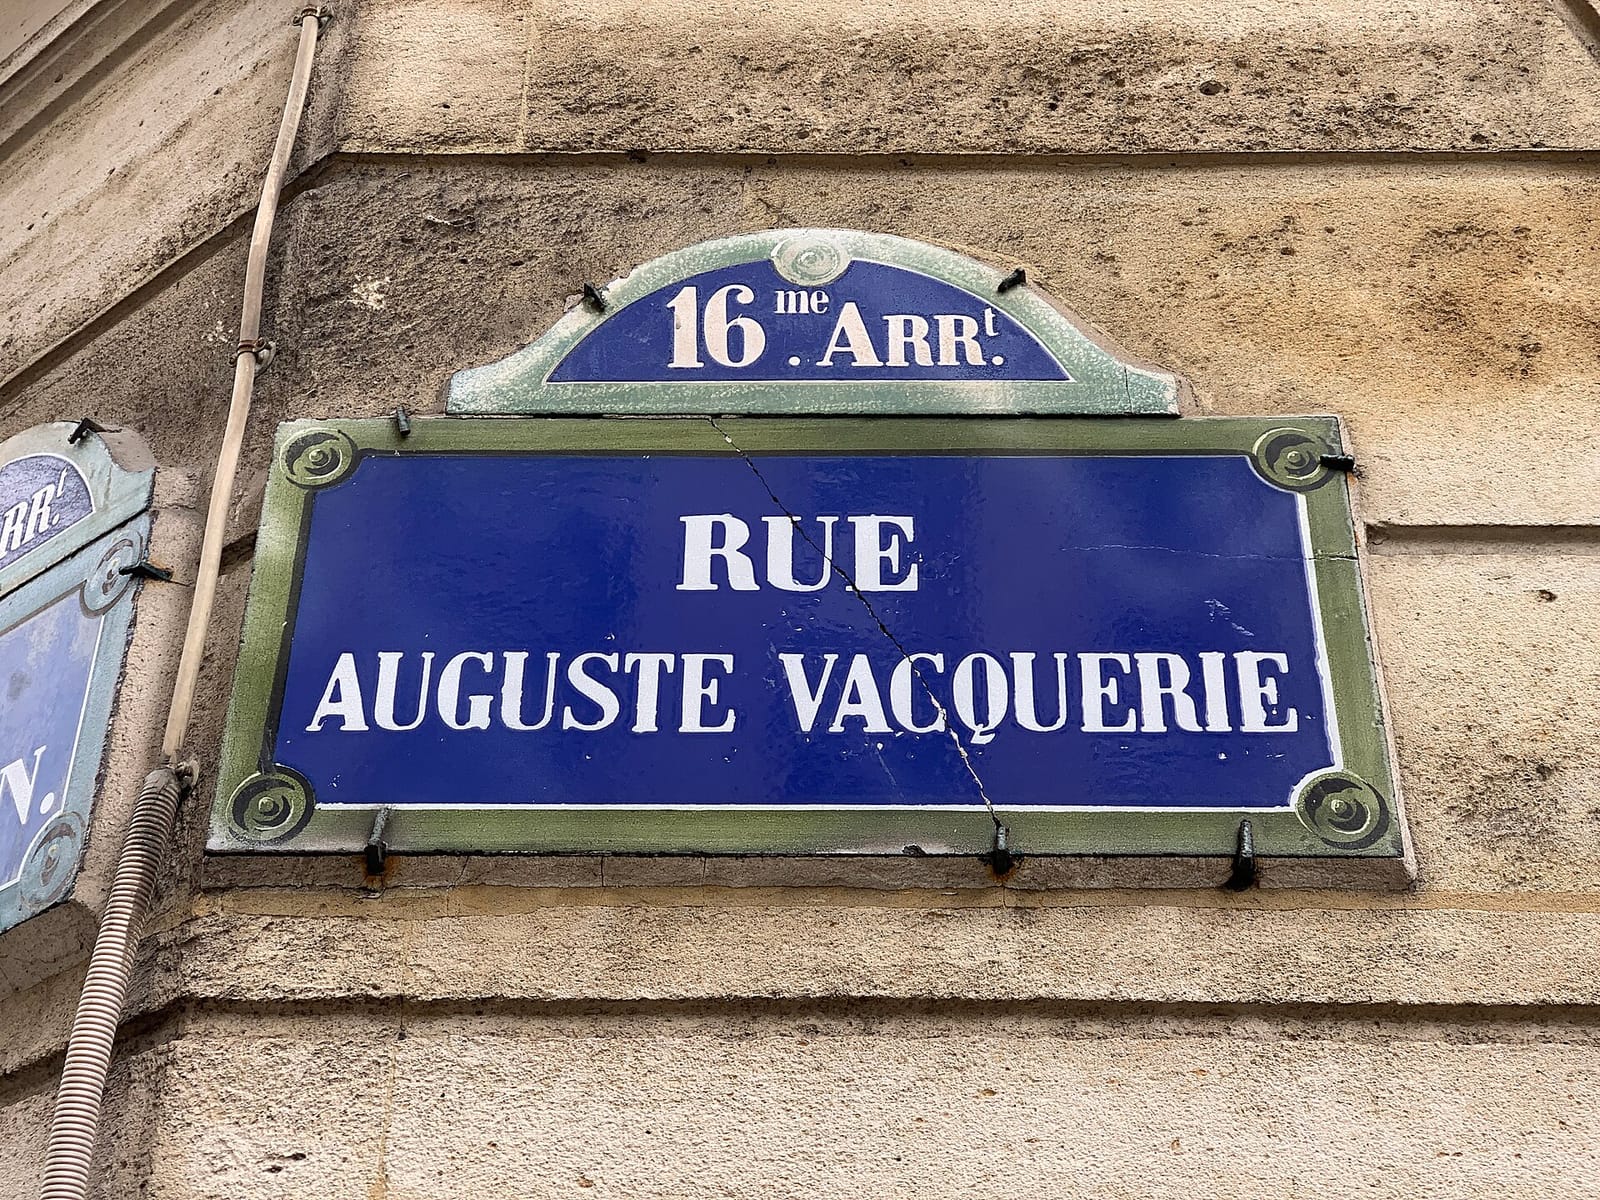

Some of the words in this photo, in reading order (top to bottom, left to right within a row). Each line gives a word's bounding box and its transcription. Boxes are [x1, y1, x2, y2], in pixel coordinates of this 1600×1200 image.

[676, 513, 920, 592] RUE
[305, 651, 737, 734] AUGUSTE
[778, 650, 1299, 745] VACQUERIE
